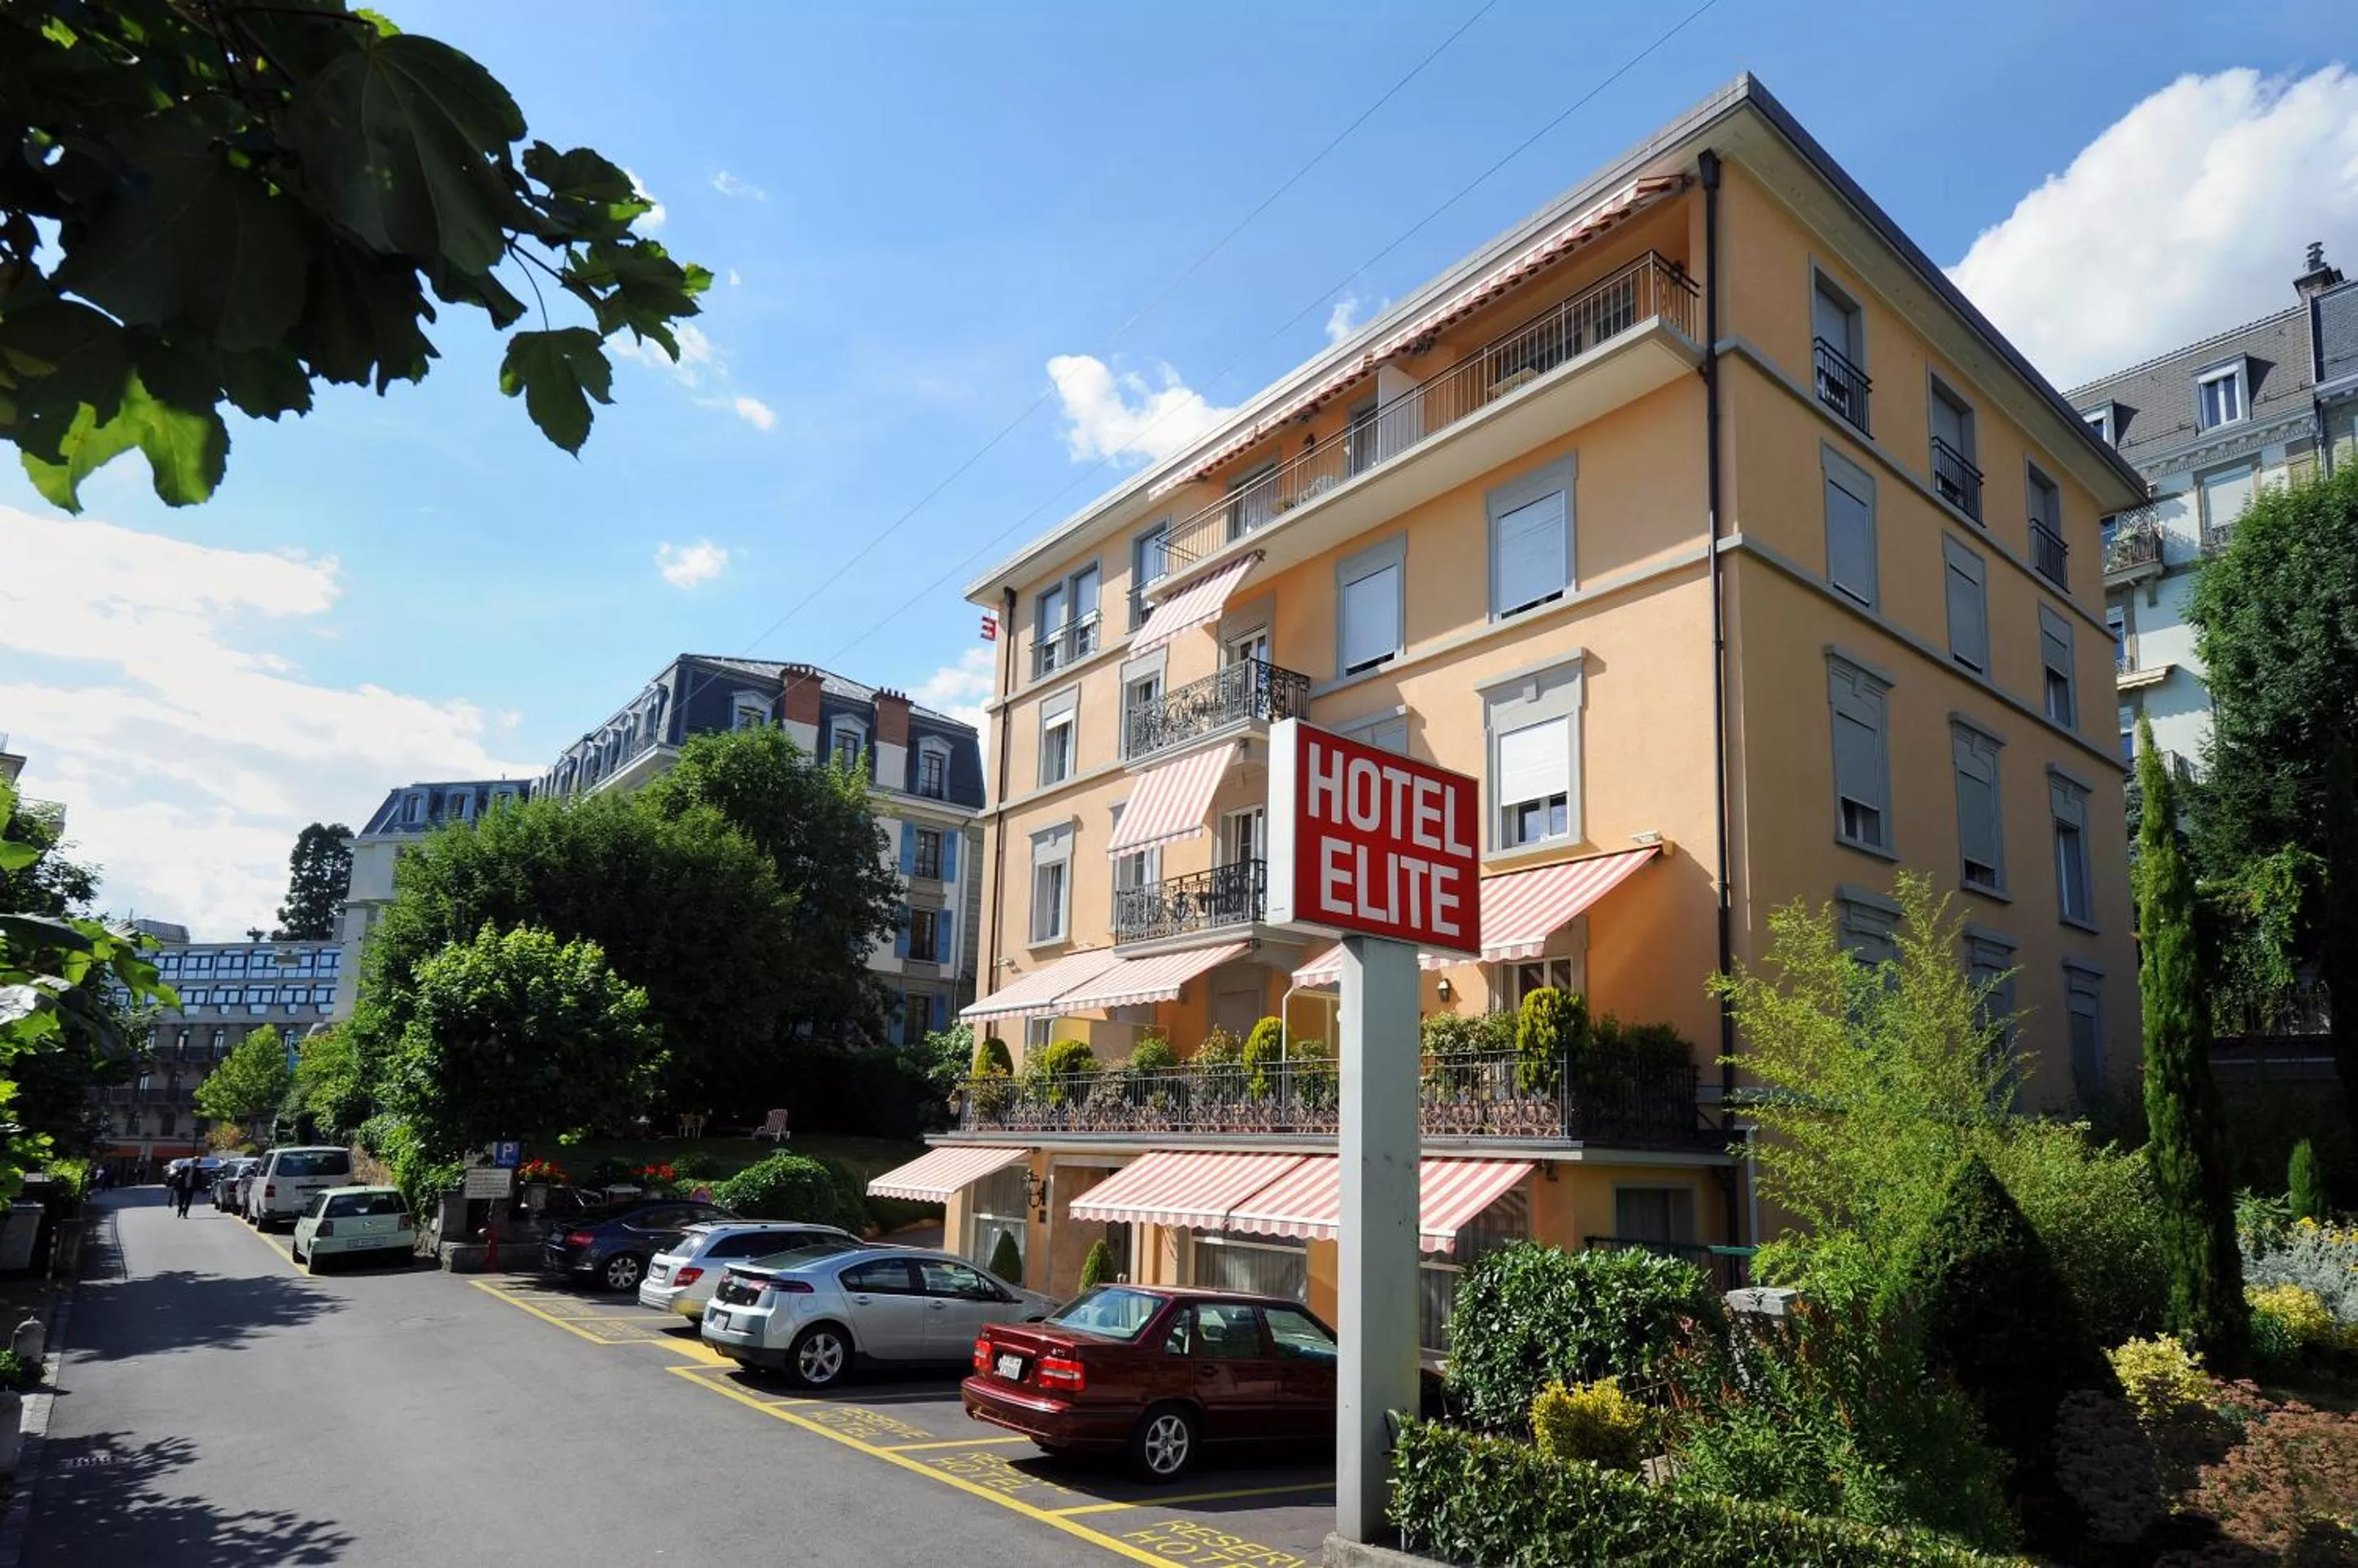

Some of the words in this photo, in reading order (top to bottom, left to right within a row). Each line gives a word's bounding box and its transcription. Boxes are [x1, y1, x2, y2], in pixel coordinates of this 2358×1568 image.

[1307, 741, 1473, 859] HOTEL
[1320, 835, 1460, 937] ELITE
[502, 1143, 514, 1158] P
[927, 1457, 1033, 1494] HOTEL
